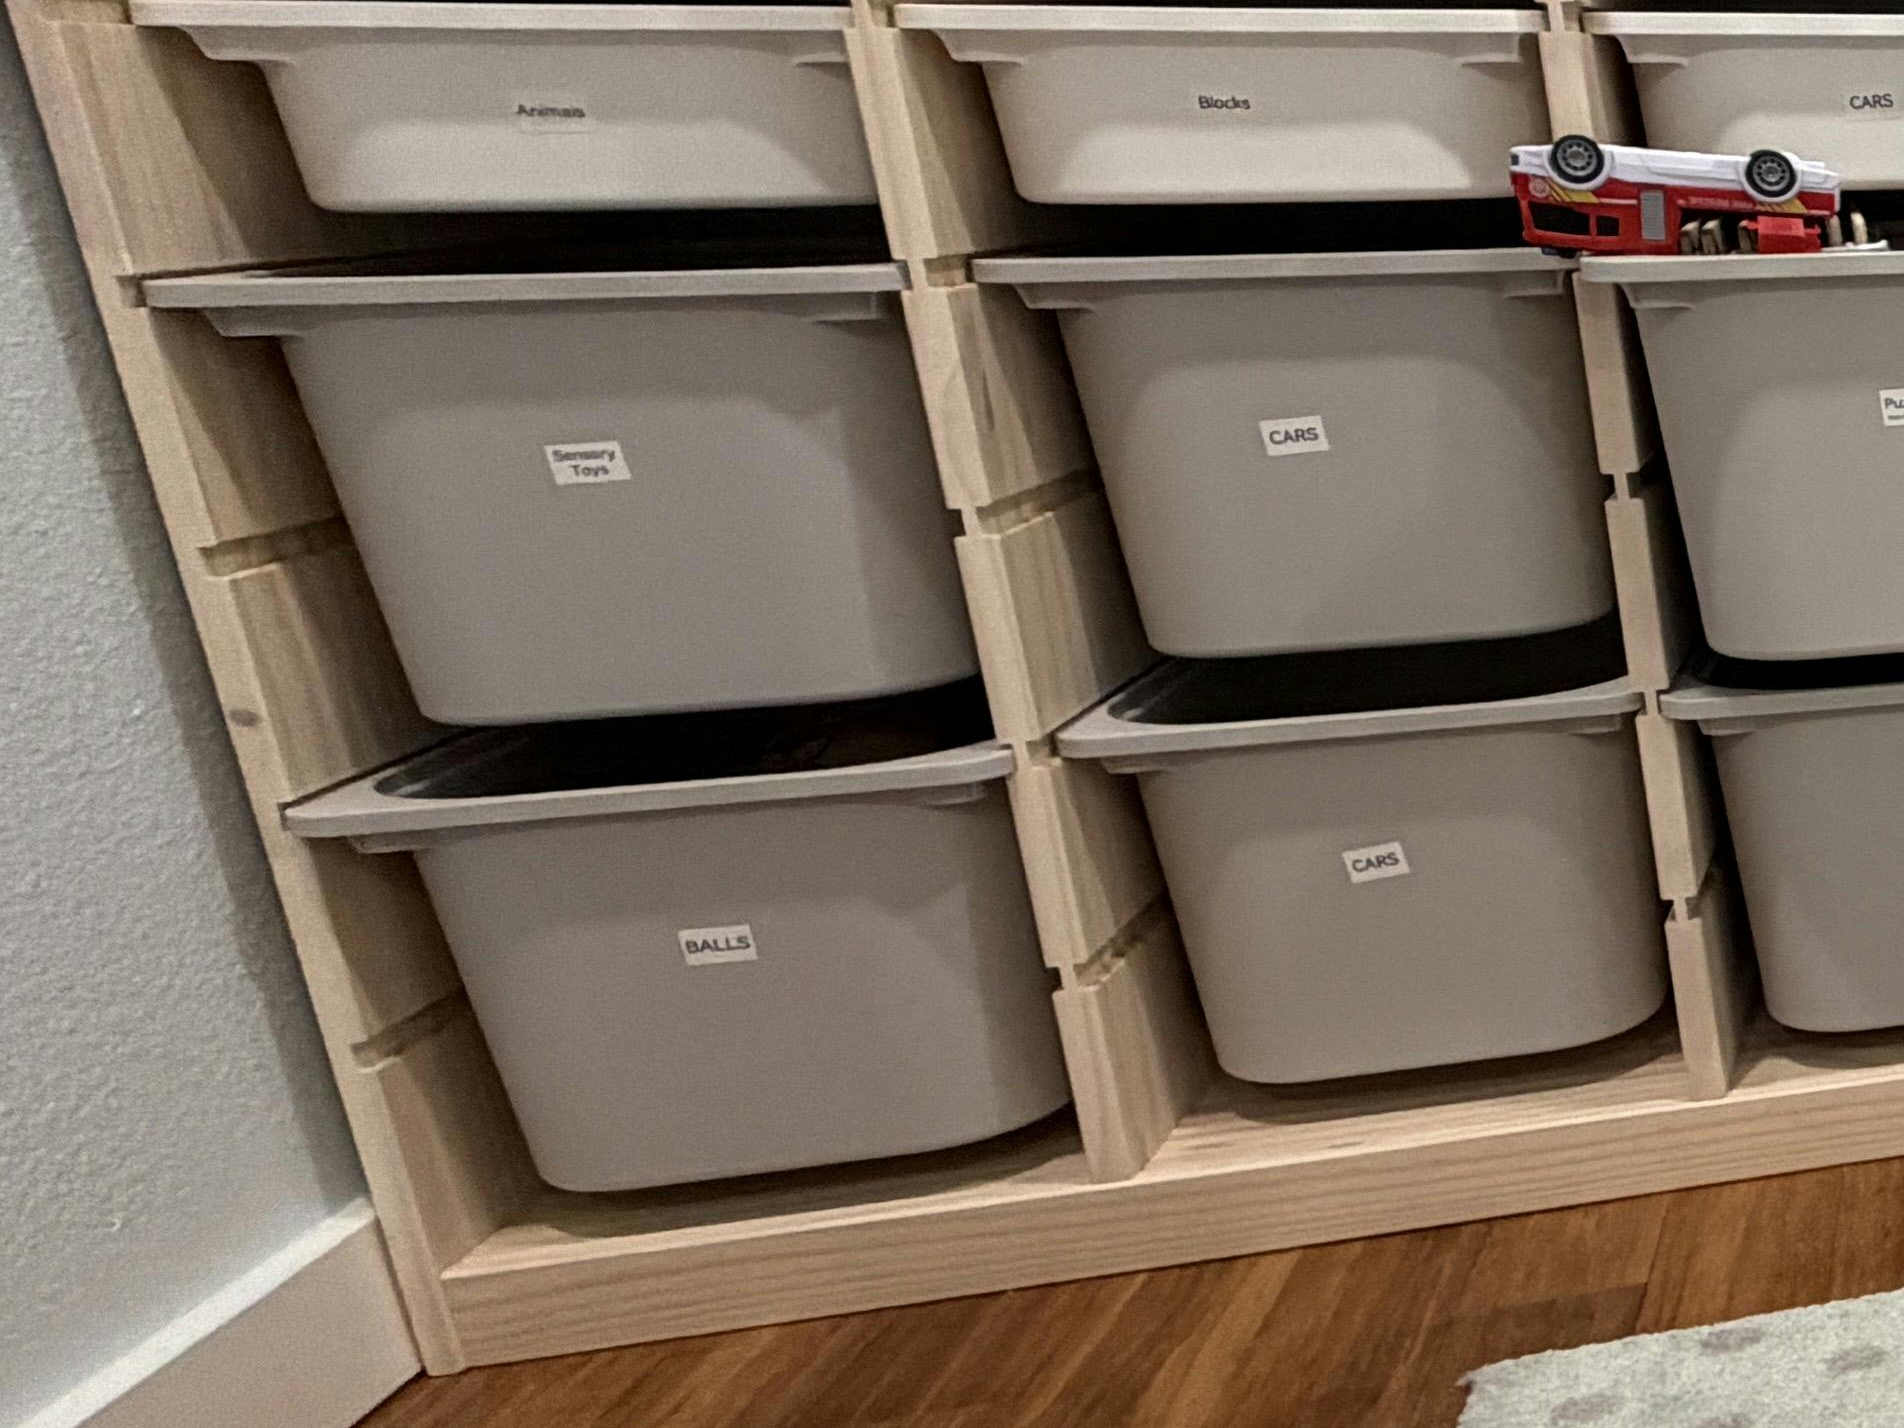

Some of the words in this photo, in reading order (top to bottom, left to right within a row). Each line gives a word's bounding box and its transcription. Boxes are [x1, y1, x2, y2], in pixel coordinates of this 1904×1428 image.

[1198, 95, 1251, 110] Blocks
[1849, 93, 1894, 110] CARS
[1269, 427, 1319, 445] CARS
[570, 464, 610, 478] Toys
[1352, 852, 1400, 872] CARS
[685, 935, 751, 954] BALLS
